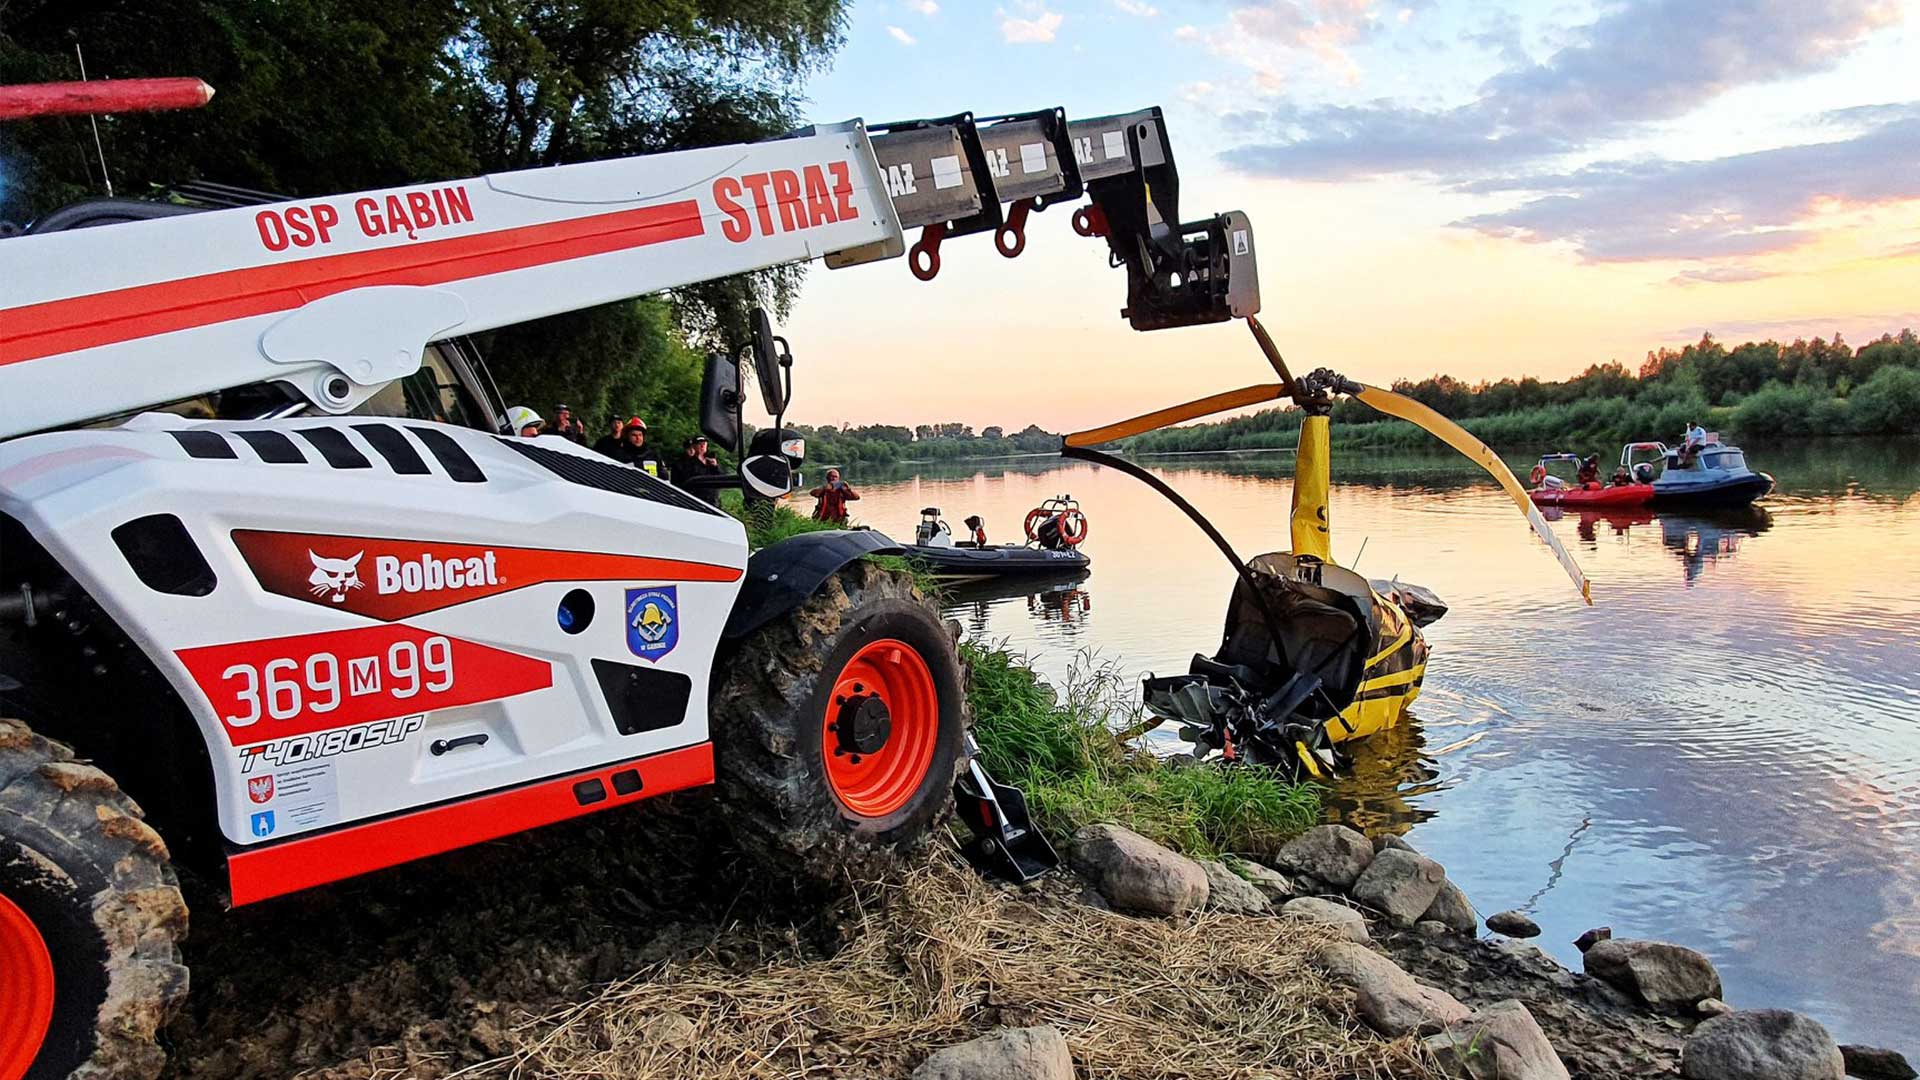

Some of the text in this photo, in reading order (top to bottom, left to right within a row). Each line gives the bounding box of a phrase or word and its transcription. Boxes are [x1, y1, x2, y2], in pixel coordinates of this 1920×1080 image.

[255, 186, 474, 251] OSP GĄBIN
[376, 551, 498, 595] Bobcat
[239, 714, 423, 773] T40.180SLP
